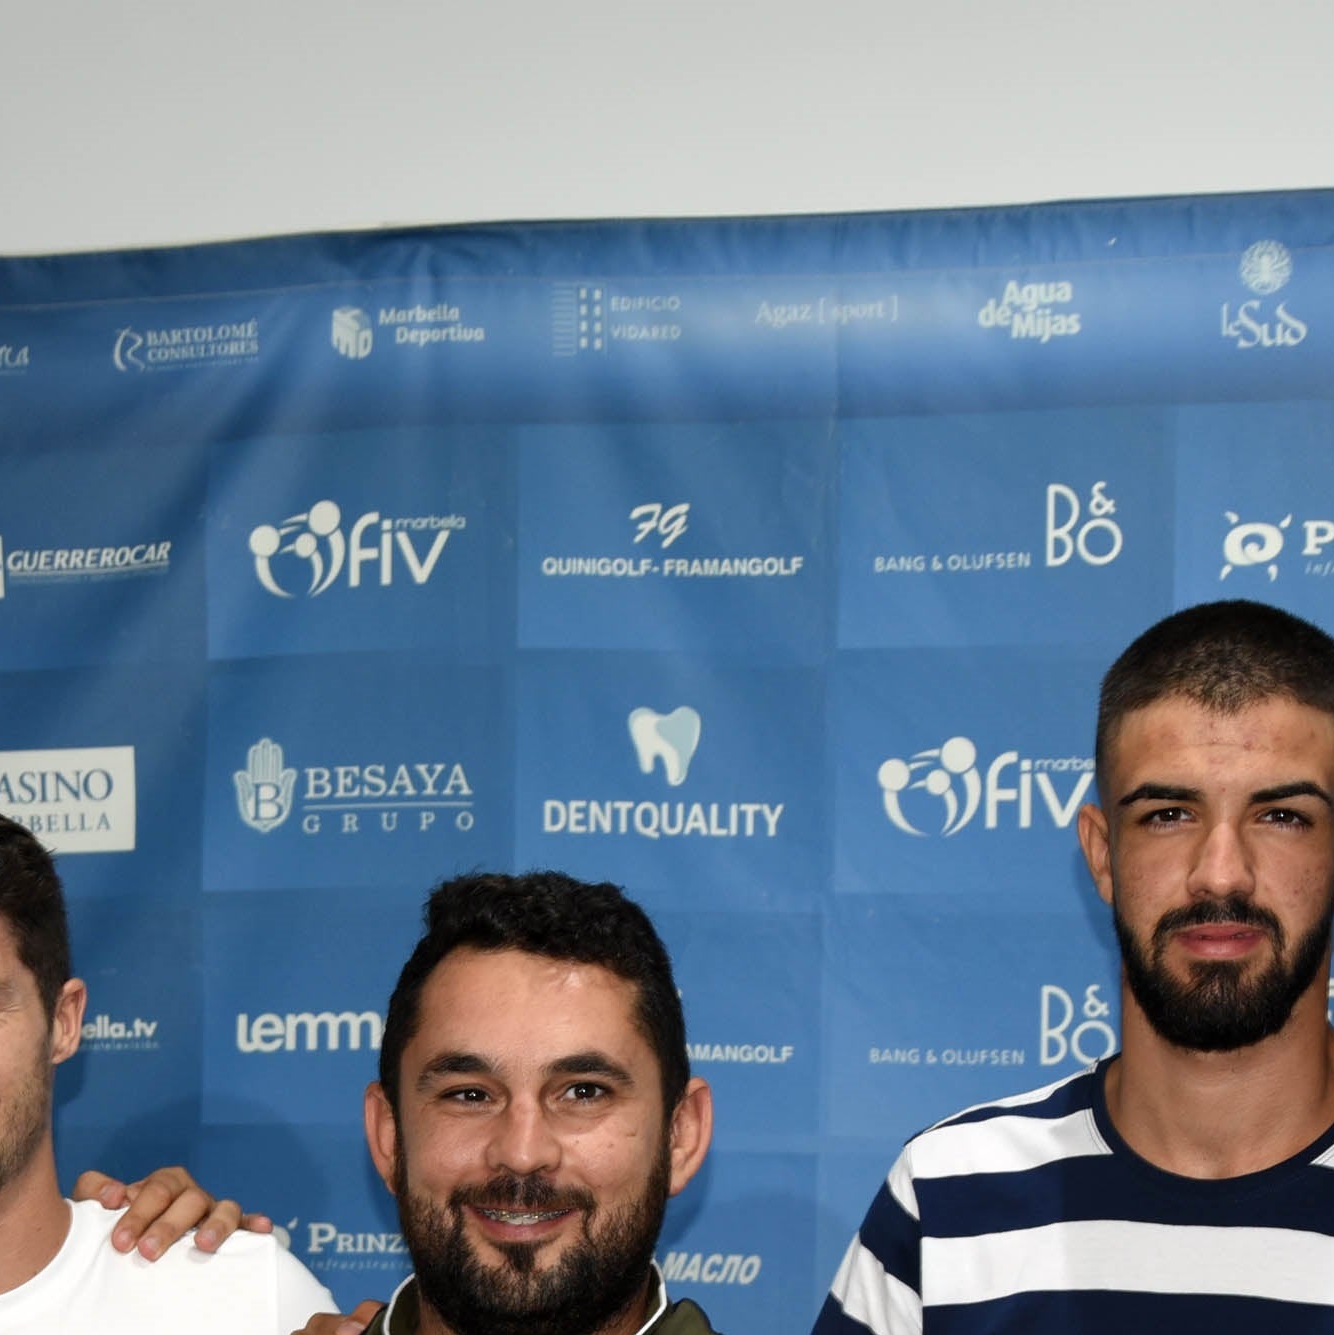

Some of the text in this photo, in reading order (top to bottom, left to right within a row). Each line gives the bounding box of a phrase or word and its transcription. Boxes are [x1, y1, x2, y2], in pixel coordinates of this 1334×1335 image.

[1003, 280, 1073, 310] Agua
[378, 304, 460, 326] Marbella
[979, 298, 1012, 328] de
[1011, 308, 1082, 344] Mijas
[146, 317, 258, 346] BARTOLOMÉ
[394, 325, 486, 347] Deportiva
[147, 340, 259, 362] CONSULTORES
[393, 513, 467, 530] marbella
[6, 541, 171, 571] GUERREROCAR
[874, 552, 1032, 573] BANG & OLUFSEN
[1034, 756, 1096, 772] marbe
[303, 763, 474, 799] BESAYA
[302, 811, 474, 834] GRUPO
[543, 799, 784, 839] DENTQUALITY
[869, 1047, 1025, 1065] BANG & OLUFSEN
[308, 1222, 409, 1253] PRINZ
